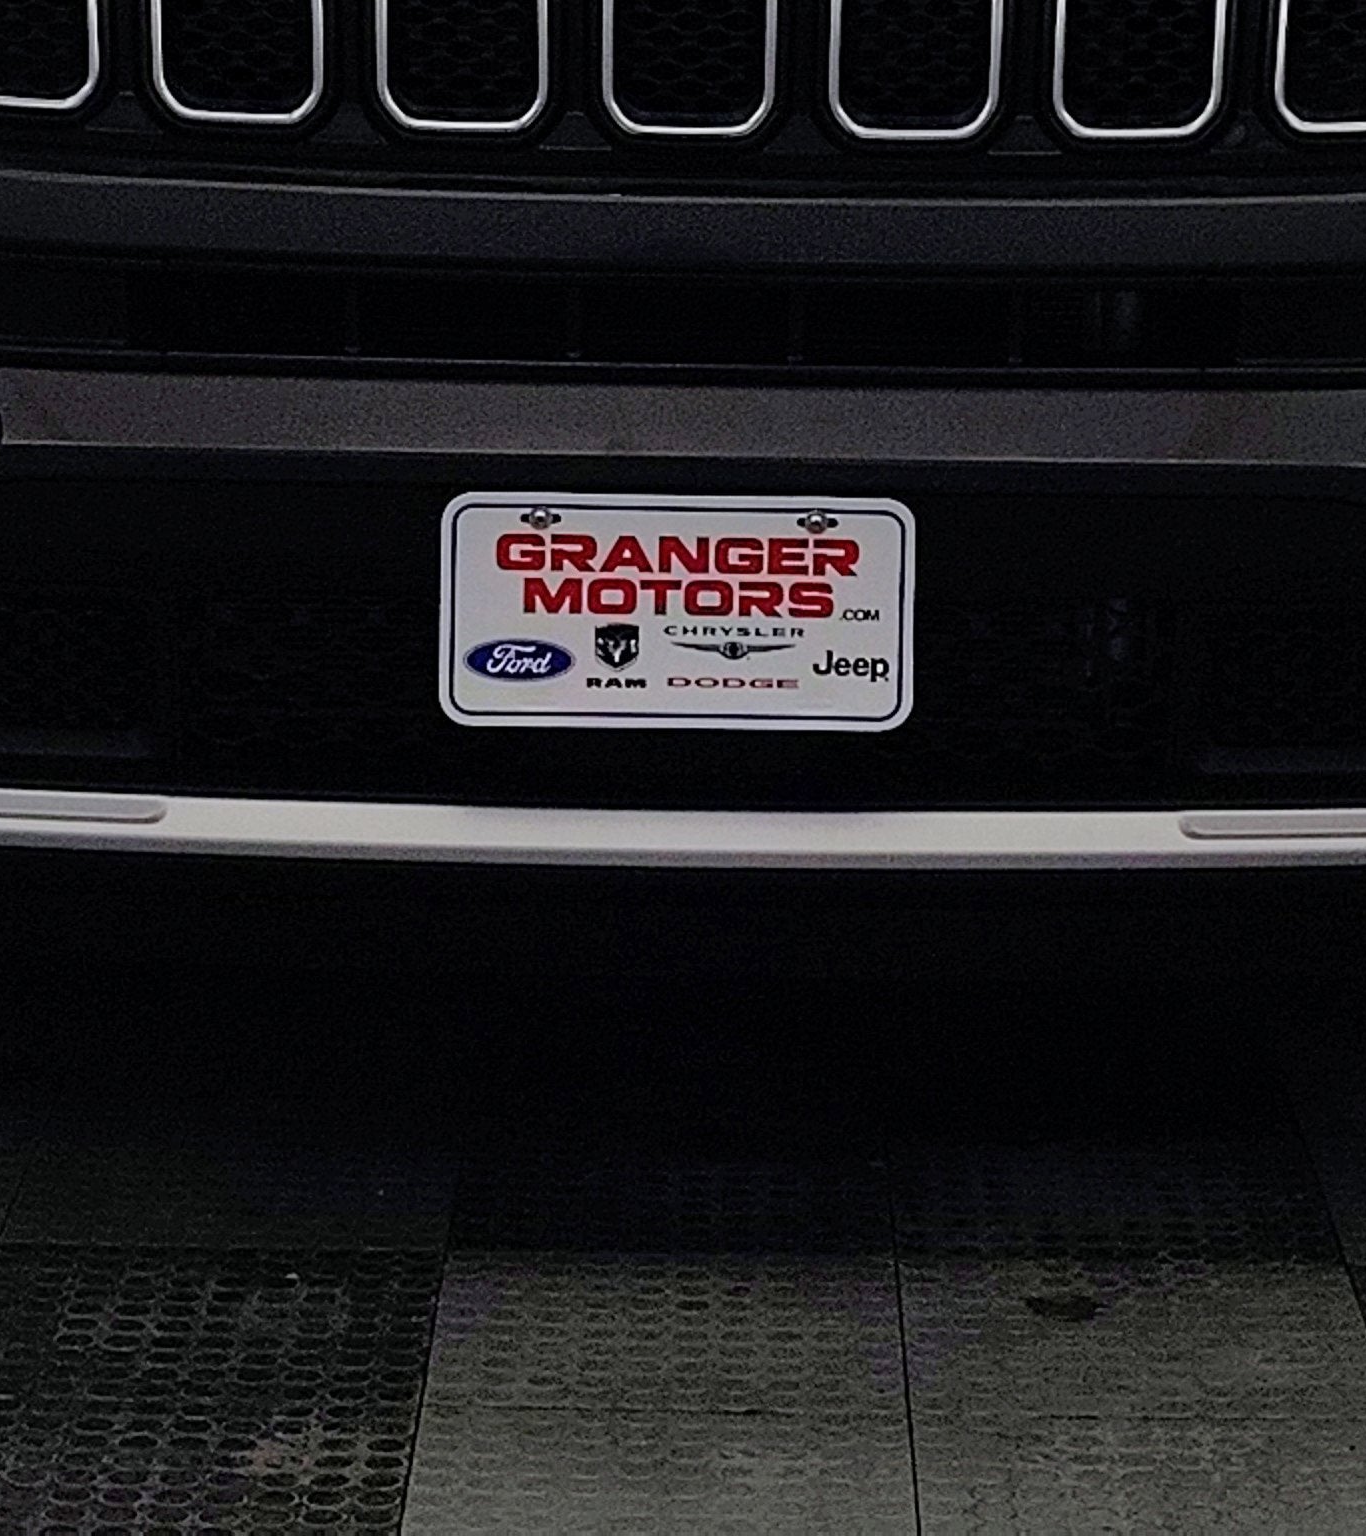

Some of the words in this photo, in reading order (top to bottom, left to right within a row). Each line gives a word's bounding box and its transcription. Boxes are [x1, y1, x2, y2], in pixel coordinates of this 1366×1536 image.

[496, 533, 860, 576] GRANGER
[523, 578, 834, 618] MOTORS
[839, 609, 880, 621] .COM
[663, 625, 805, 637] CHRYSLER
[486, 643, 552, 674] Ford
[812, 650, 890, 682] Jeep
[586, 677, 647, 689] RAM
[667, 677, 800, 689] DODGE
